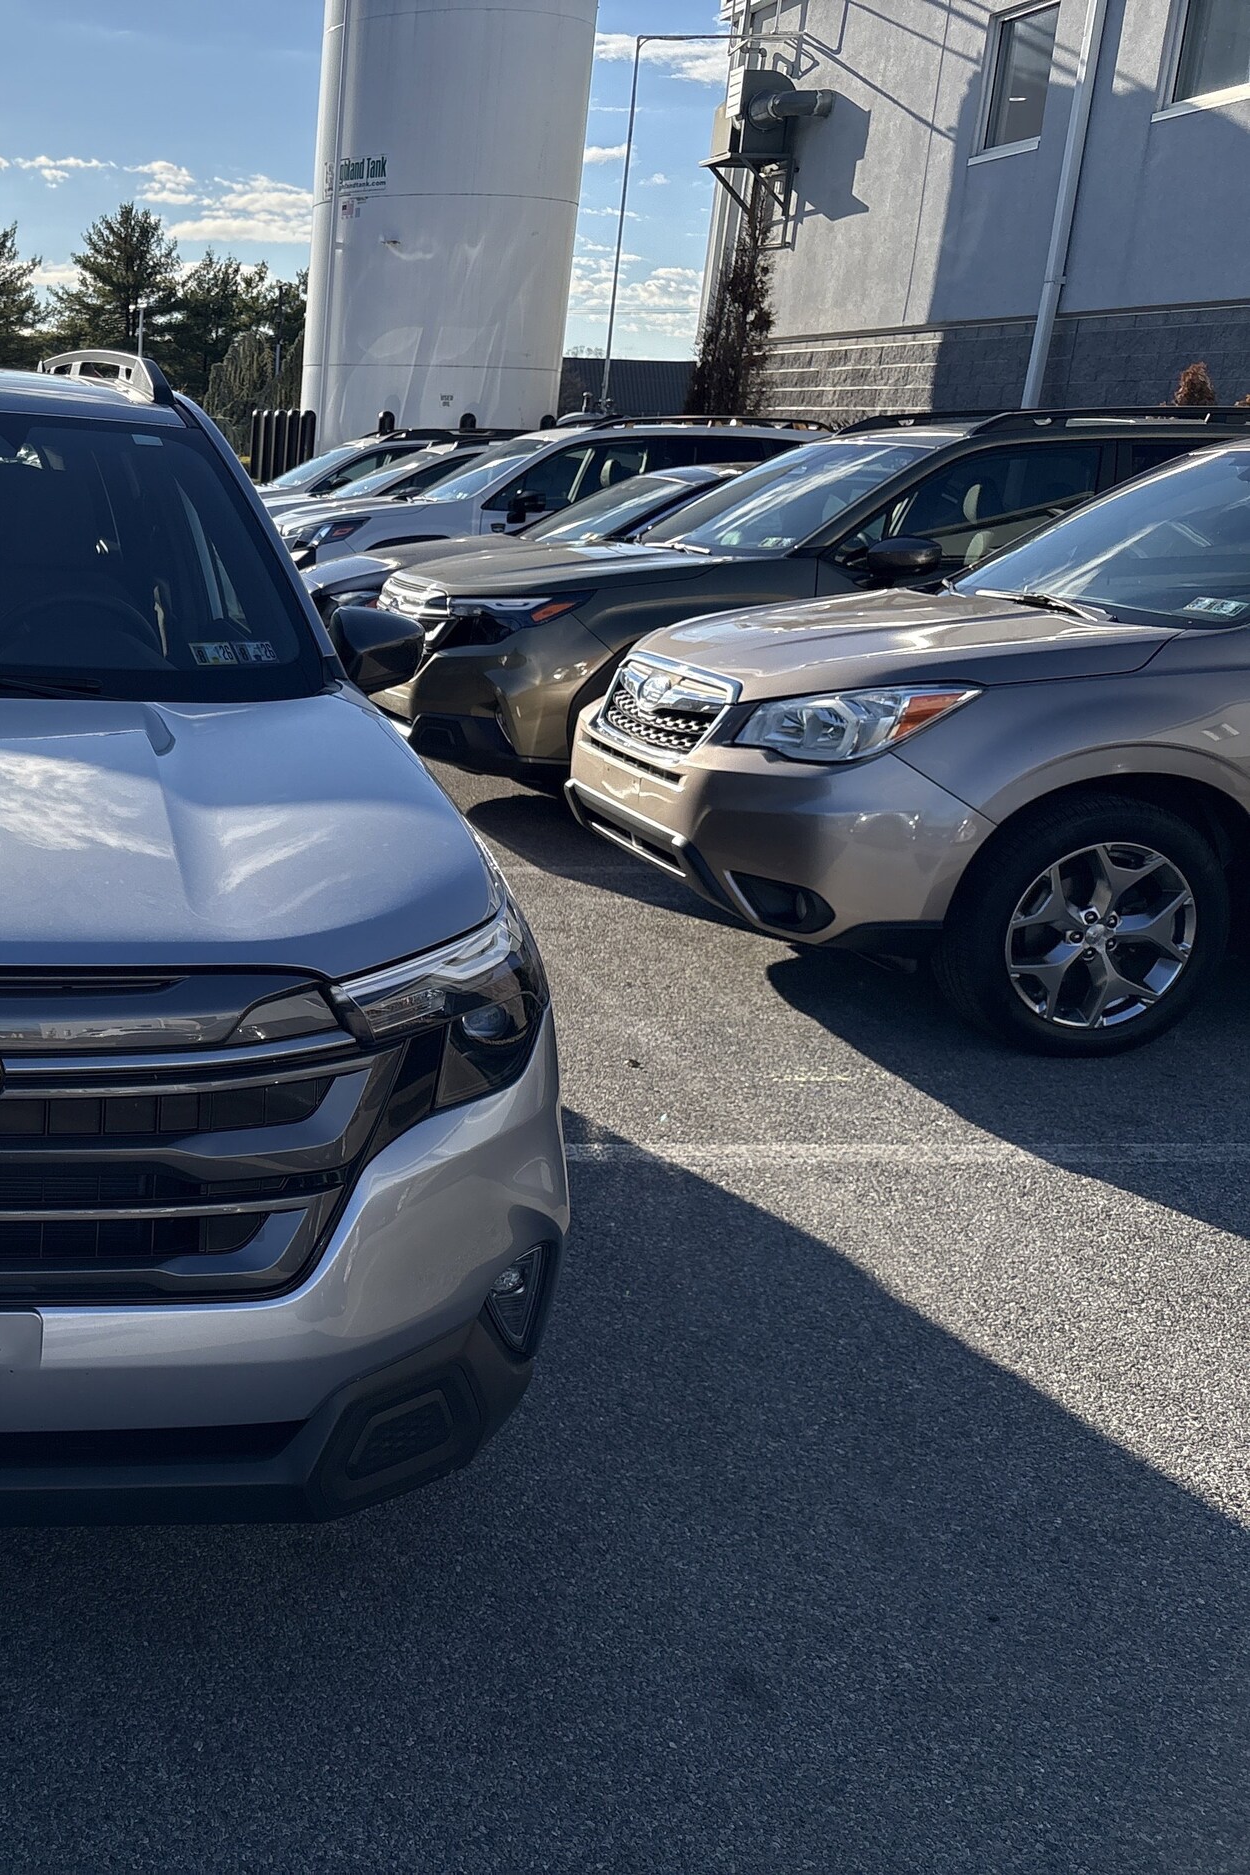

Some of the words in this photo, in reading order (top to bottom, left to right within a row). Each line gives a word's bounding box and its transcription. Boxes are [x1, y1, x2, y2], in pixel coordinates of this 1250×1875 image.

[339, 158, 365, 184] ghland
[366, 156, 387, 178] Tank
[219, 645, 234, 661] 26
[260, 643, 276, 659] 26
